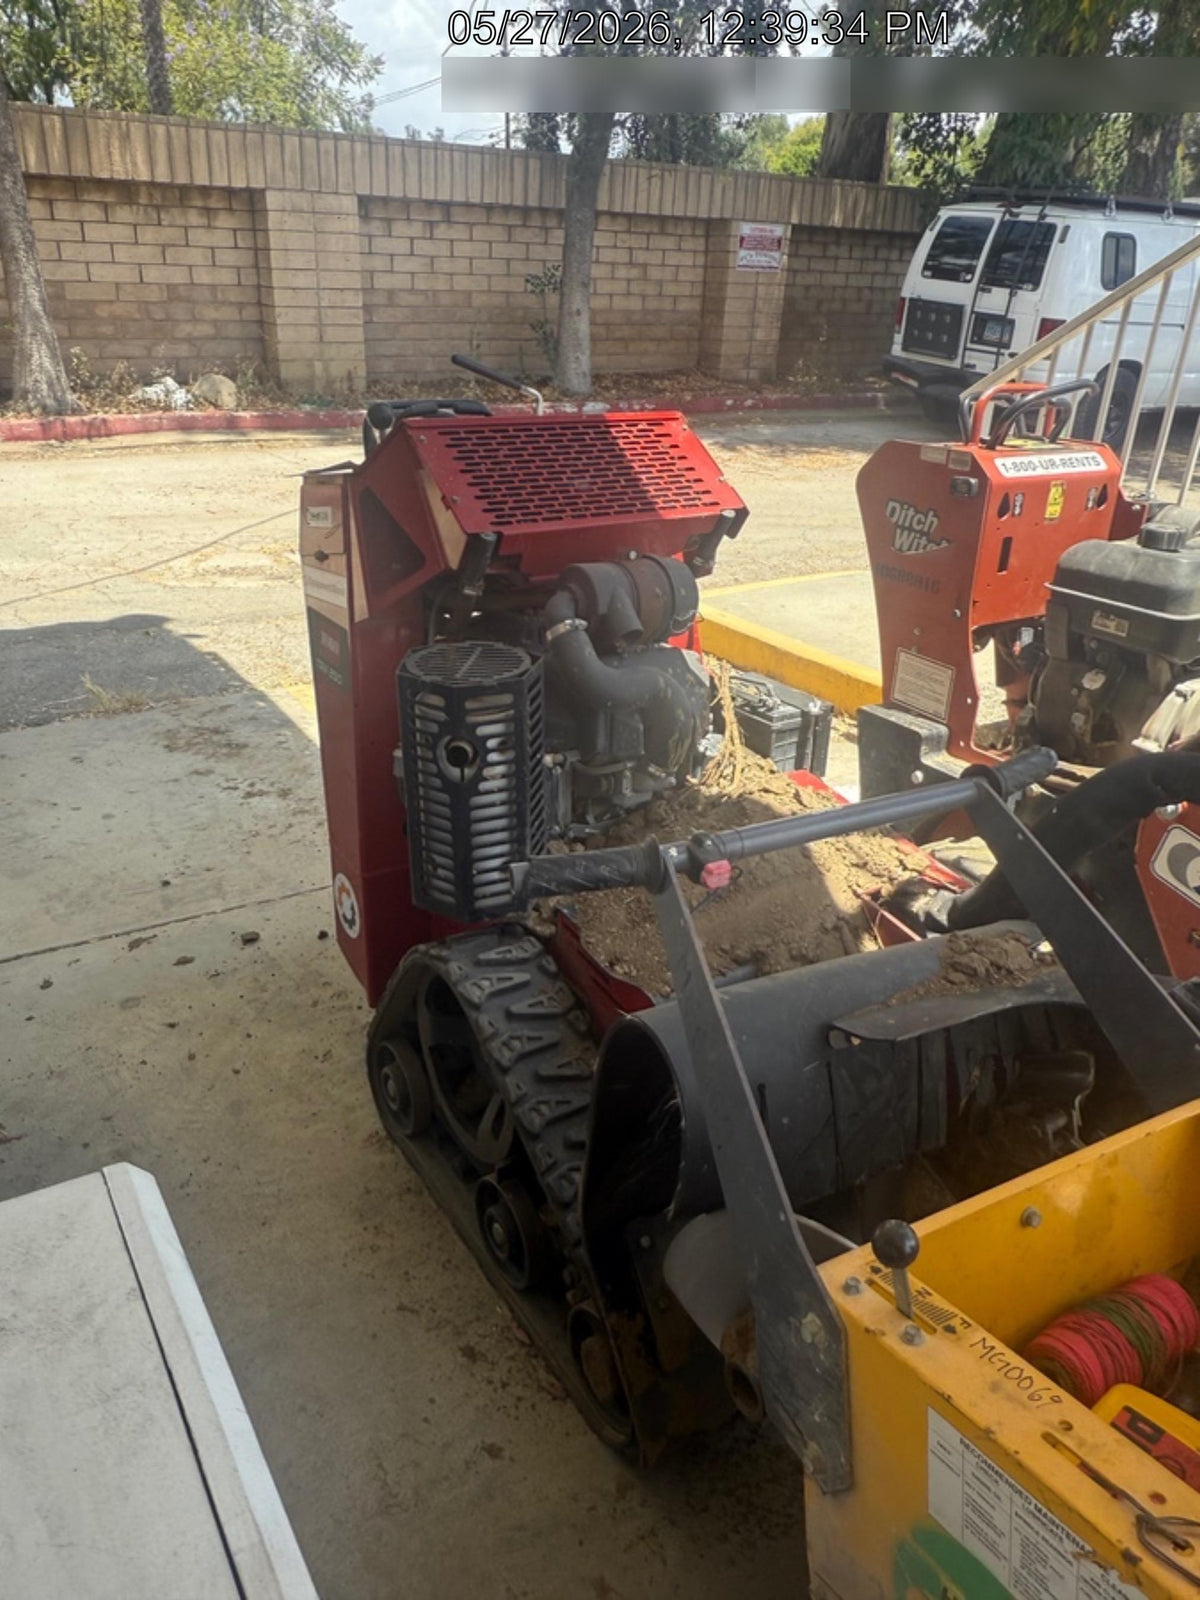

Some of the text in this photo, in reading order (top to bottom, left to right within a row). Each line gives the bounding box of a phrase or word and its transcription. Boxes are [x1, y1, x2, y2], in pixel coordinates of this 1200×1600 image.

[1001, 456, 1101, 473] 1-800-UR-RENTS
[885, 499, 939, 533] Ditch
[893, 528, 949, 553] Wit
